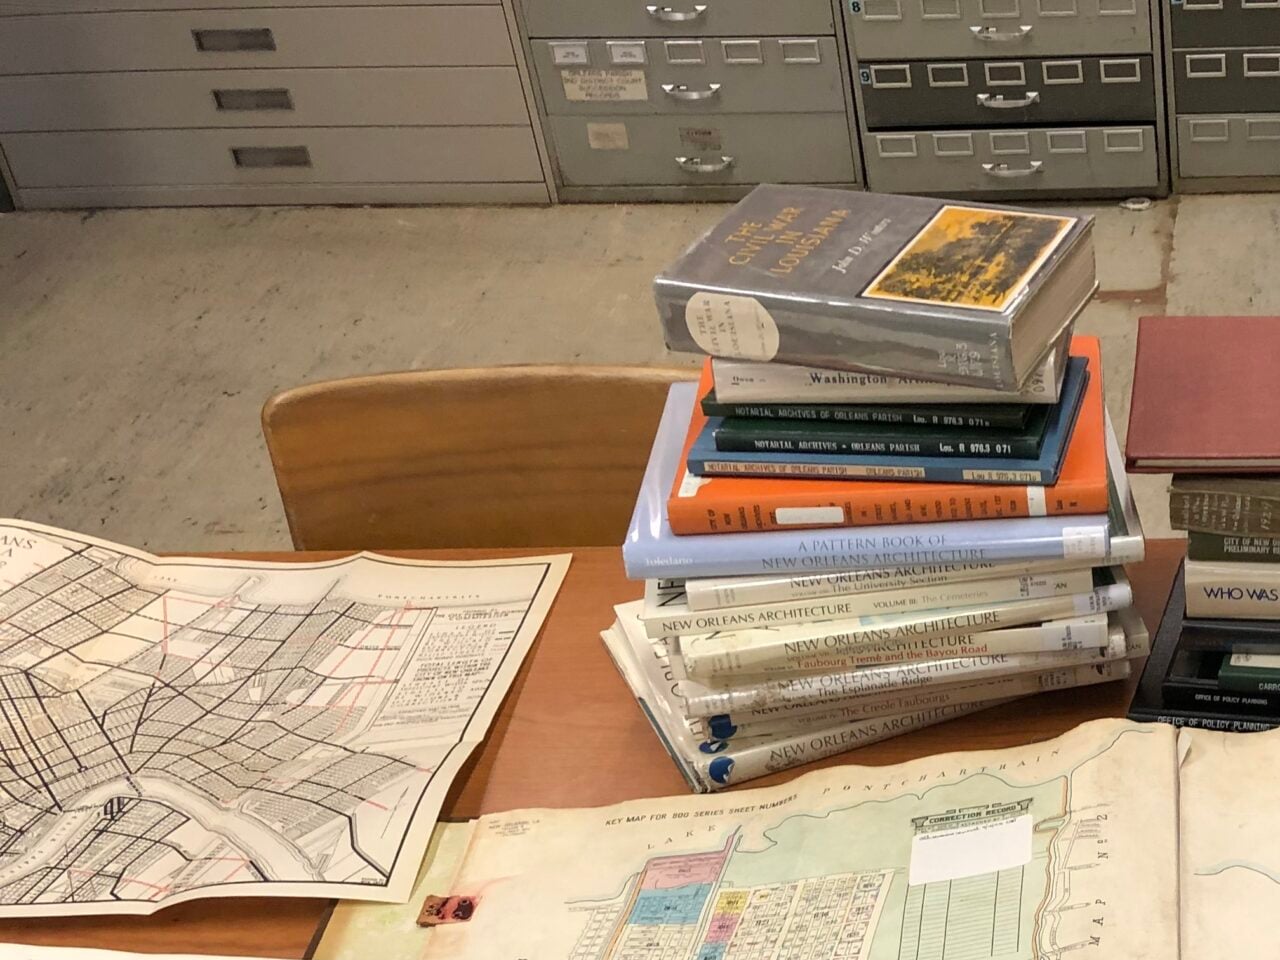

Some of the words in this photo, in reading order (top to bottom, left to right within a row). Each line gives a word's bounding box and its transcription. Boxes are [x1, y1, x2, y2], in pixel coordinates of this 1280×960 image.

[852, 2, 861, 13] 8
[861, 71, 869, 82] 9
[724, 221, 763, 244] THE
[728, 231, 774, 266] CIVIL
[770, 206, 804, 231] WAR
[810, 373, 887, 386] Washington
[735, 407, 774, 417] NOTARIAL
[778, 408, 817, 419] ARCHIVES
[820, 410, 831, 419] OF
[834, 410, 869, 421] ORLEANS
[872, 413, 902, 422] PARISH
[754, 439, 794, 449] NOTARIAL
[798, 440, 837, 450] ARCHIVES
[851, 442, 886, 451] ORLEANS
[889, 443, 920, 452] PARISH
[798, 540, 808, 552] A
[813, 536, 877, 551] PATTERN
[882, 535, 923, 548] BOOK
[928, 534, 947, 546] OF
[1224, 537, 1239, 546] CITY
[1242, 538, 1251, 547] OF
[1254, 538, 1270, 547] NEW
[1224, 545, 1270, 555] PRELIMINARY
[762, 556, 797, 569] NEW
[801, 553, 868, 567] ORLEANS
[873, 548, 986, 564] ARCHITECTURE
[790, 577, 822, 589] NEW
[832, 583, 850, 592] The
[854, 578, 905, 591] University
[873, 600, 908, 609] VOLUME
[921, 594, 937, 603] The
[1204, 586, 1243, 600] WHO
[1246, 588, 1278, 601] WAS
[662, 620, 693, 632] NEW
[696, 613, 755, 628] ORLEANS
[758, 603, 852, 623] ARCHITECTURE
[784, 639, 821, 654] NEW
[824, 629, 892, 649] ORLEANS
[894, 611, 1001, 638] ARCHITECTURE
[797, 657, 847, 671] Faubourg
[885, 652, 904, 662] and
[907, 650, 924, 660] the
[925, 647, 958, 660] Bayou
[960, 644, 988, 655] Road
[777, 679, 818, 693] NEW
[820, 670, 890, 689] ORLEANS
[897, 653, 1008, 676] ARCHITECTURE
[816, 687, 837, 698] The
[842, 680, 897, 695] Esplanade
[902, 674, 933, 687] Ridge
[862, 702, 896, 714] Creole
[1222, 696, 1239, 704] POLICY
[769, 743, 805, 762] NEW
[810, 725, 877, 751] ORLEANS
[881, 701, 985, 732] ARCHITECTURE
[1158, 716, 1188, 727] OFFICE
[1202, 720, 1229, 731] POLICY
[823, 750, 1059, 795] PONTCHARTRAIN
[605, 817, 624, 827] KEY
[626, 814, 647, 823] MAP
[650, 812, 667, 820] FOR
[694, 808, 724, 818] SERIES
[728, 805, 755, 815] SHEET
[759, 793, 798, 811] NUMBERS
[929, 811, 983, 825] CORRECTION
[985, 803, 1017, 817] RECORD
[648, 824, 716, 850] LAKE
